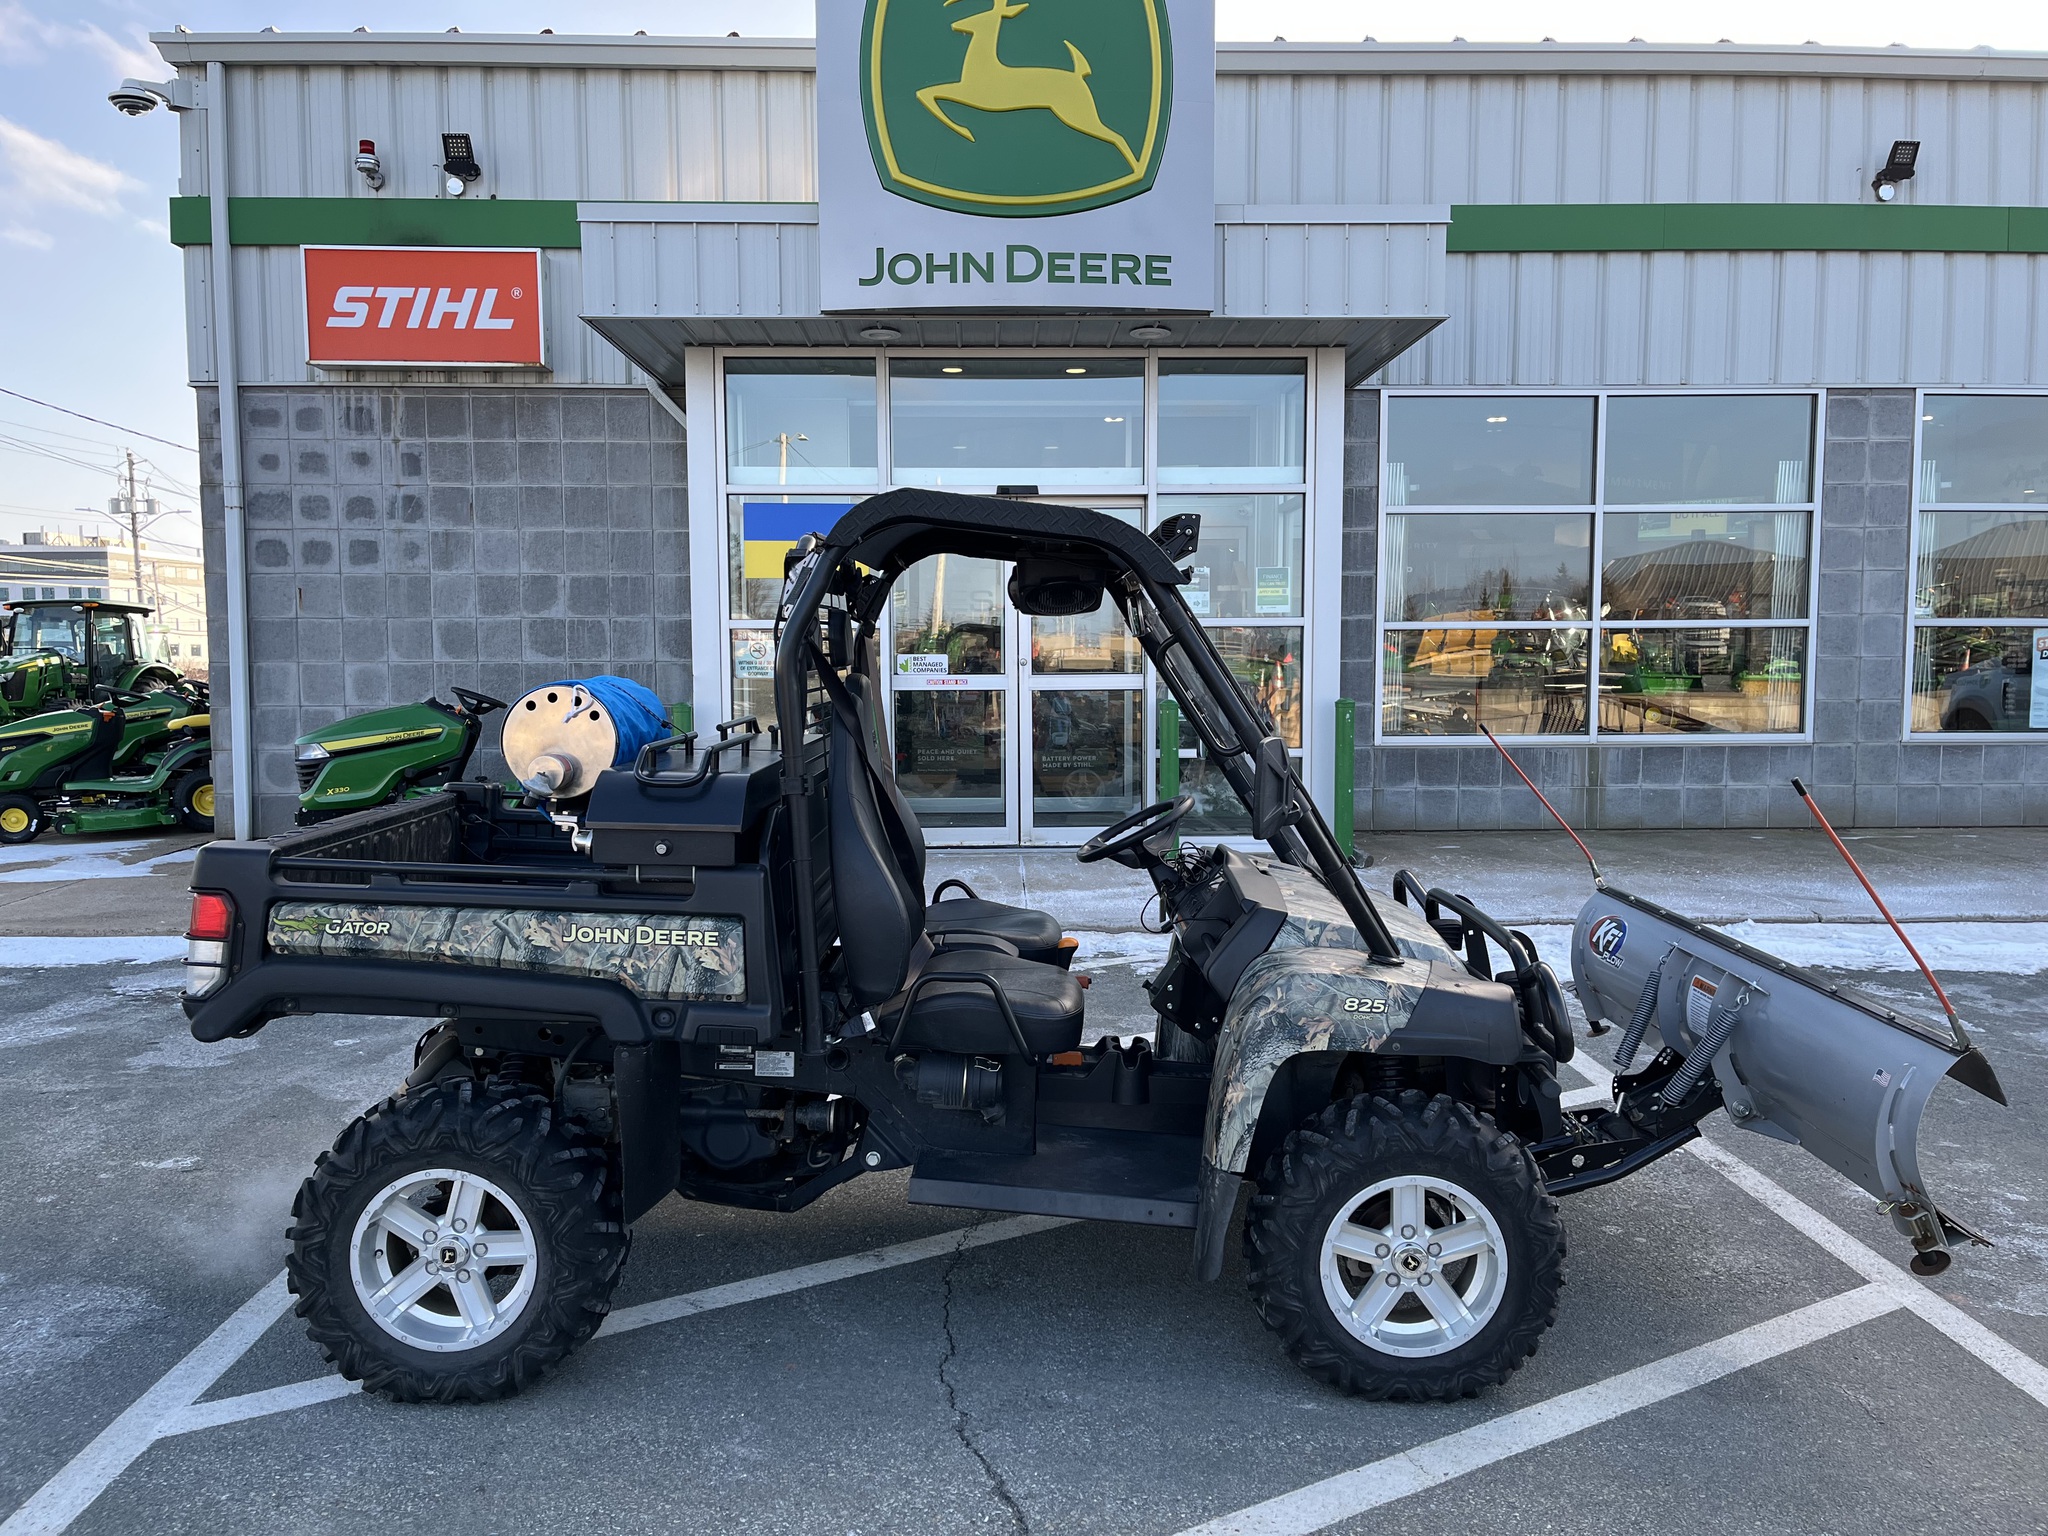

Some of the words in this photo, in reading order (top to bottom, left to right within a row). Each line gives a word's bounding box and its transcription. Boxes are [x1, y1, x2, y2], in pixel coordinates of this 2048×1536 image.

[858, 247, 995, 286] JOHN
[1005, 244, 1172, 287] DEERE
[325, 286, 515, 330] STIHL
[402, 731, 425, 739] DEERE
[326, 786, 350, 796] X330
[325, 919, 391, 935] GATOR
[562, 923, 630, 944] JOHN
[635, 925, 720, 947] DEERE
[1343, 997, 1389, 1014] 825i
